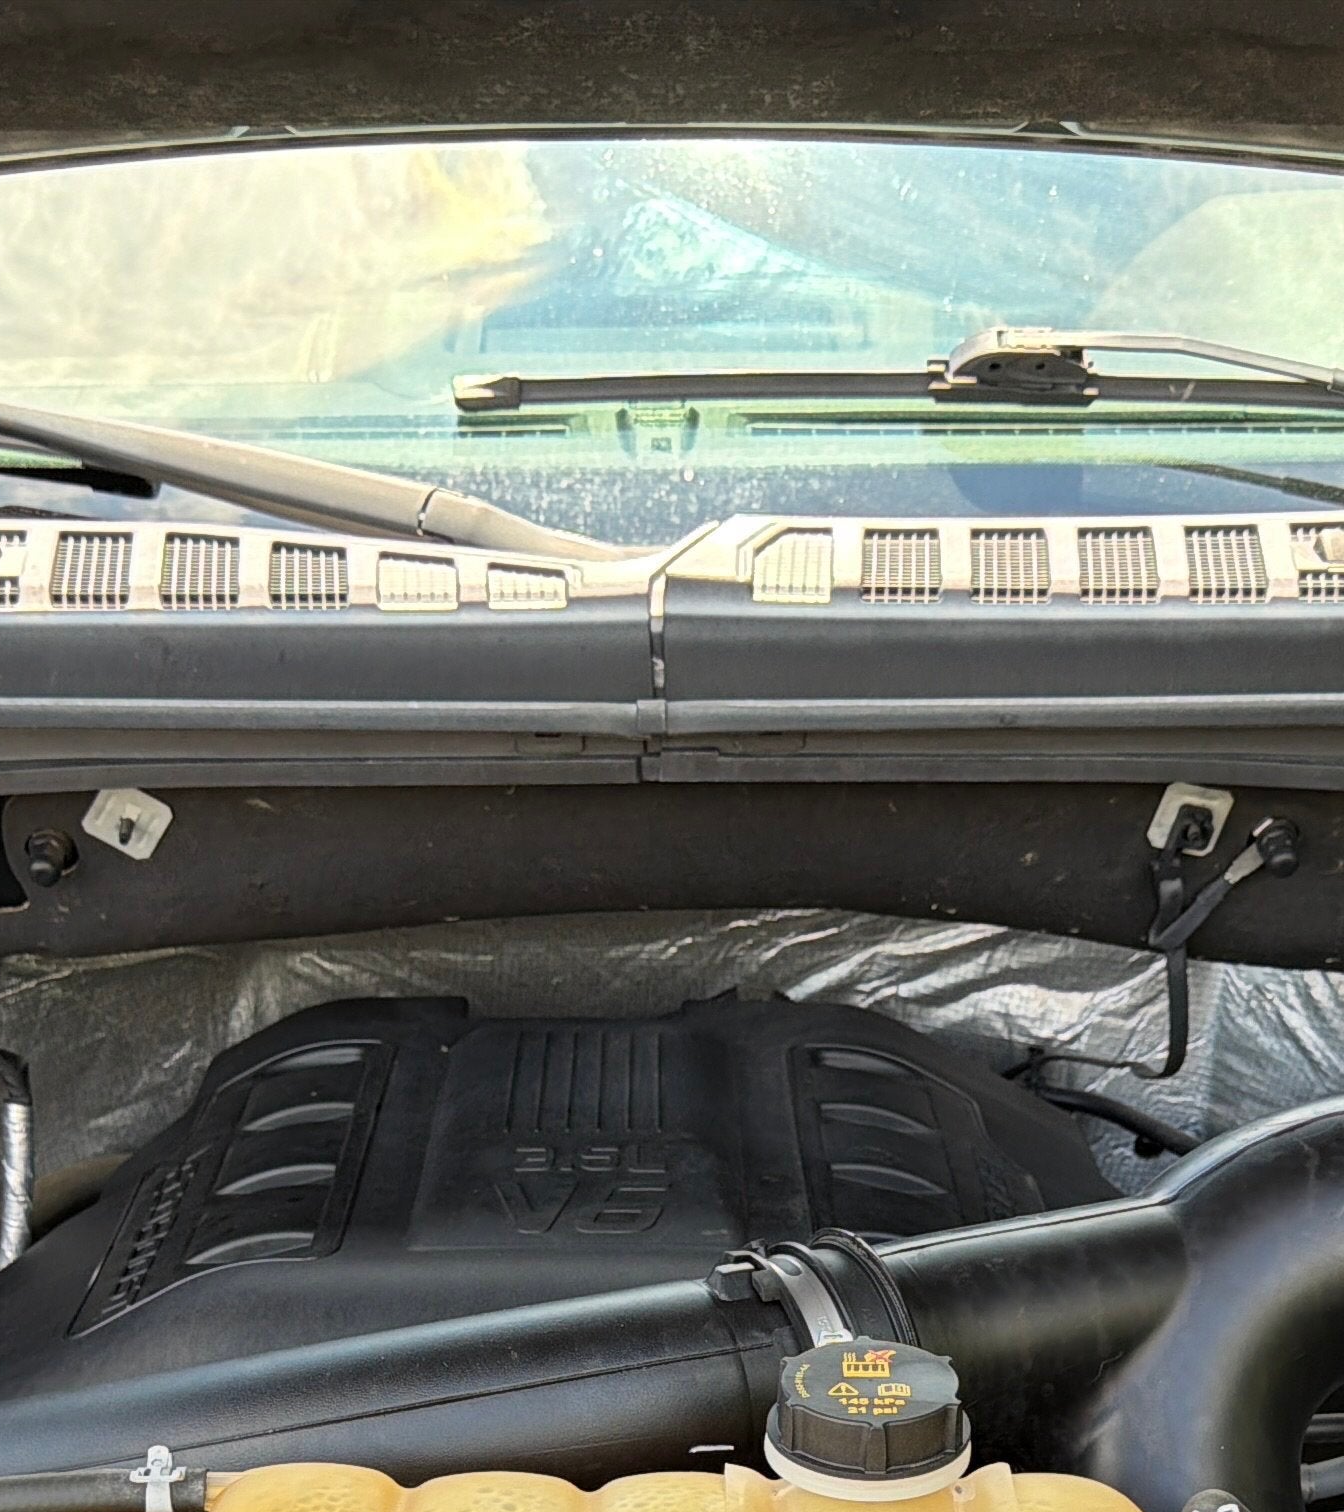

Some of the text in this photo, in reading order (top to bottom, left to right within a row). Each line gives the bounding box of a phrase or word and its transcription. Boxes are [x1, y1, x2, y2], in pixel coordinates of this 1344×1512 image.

[493, 1182, 672, 1234] V6
[873, 1397, 905, 1406] kPa
[847, 1406, 898, 1416] 21 psi
